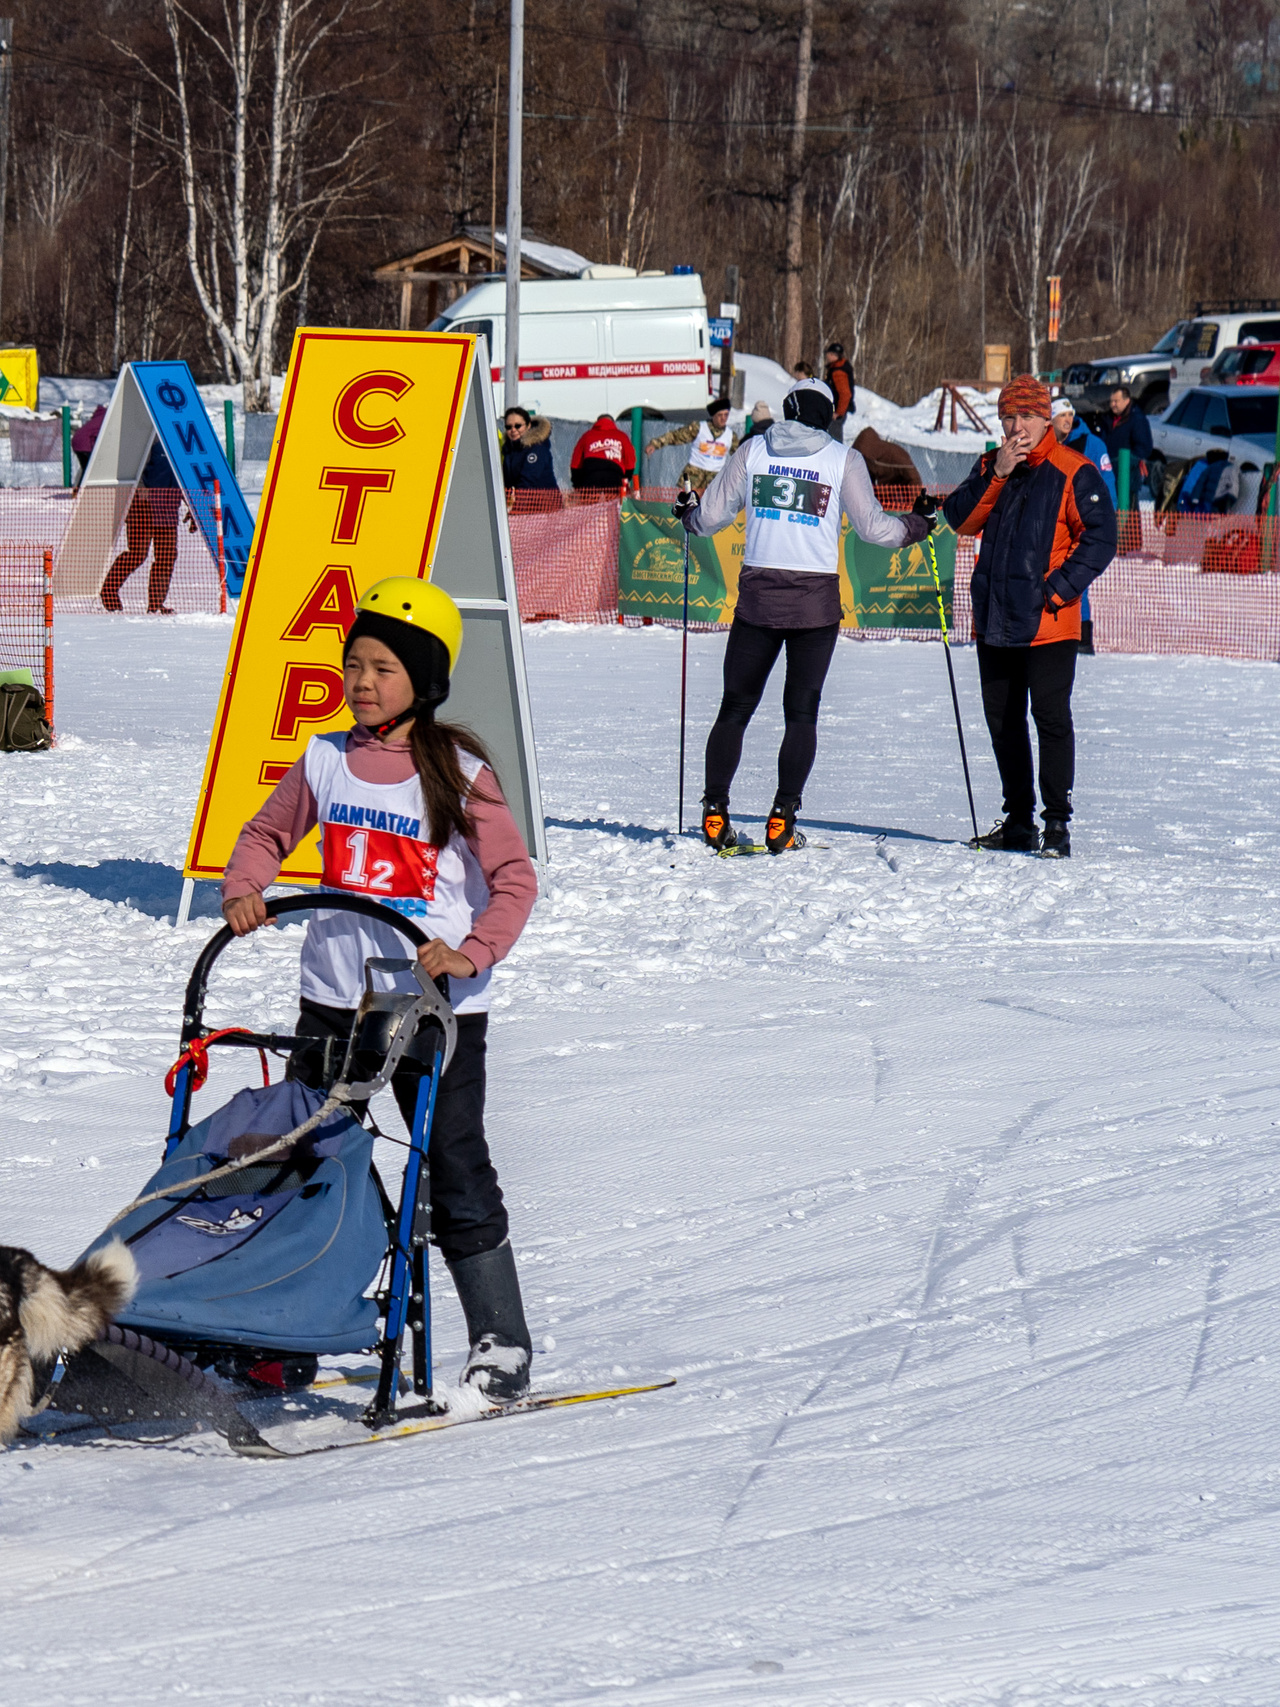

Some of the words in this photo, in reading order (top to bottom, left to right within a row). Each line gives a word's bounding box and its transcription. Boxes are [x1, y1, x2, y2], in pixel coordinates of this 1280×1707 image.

[543, 365, 576, 378] СКОРАЯ
[587, 363, 651, 377] МЕДИЦИНСКАЯ
[663, 362, 701, 375] ПОМОЩЬ
[768, 464, 820, 482] КАМЧАТКА
[328, 802, 421, 839] КАМЧАТКА
